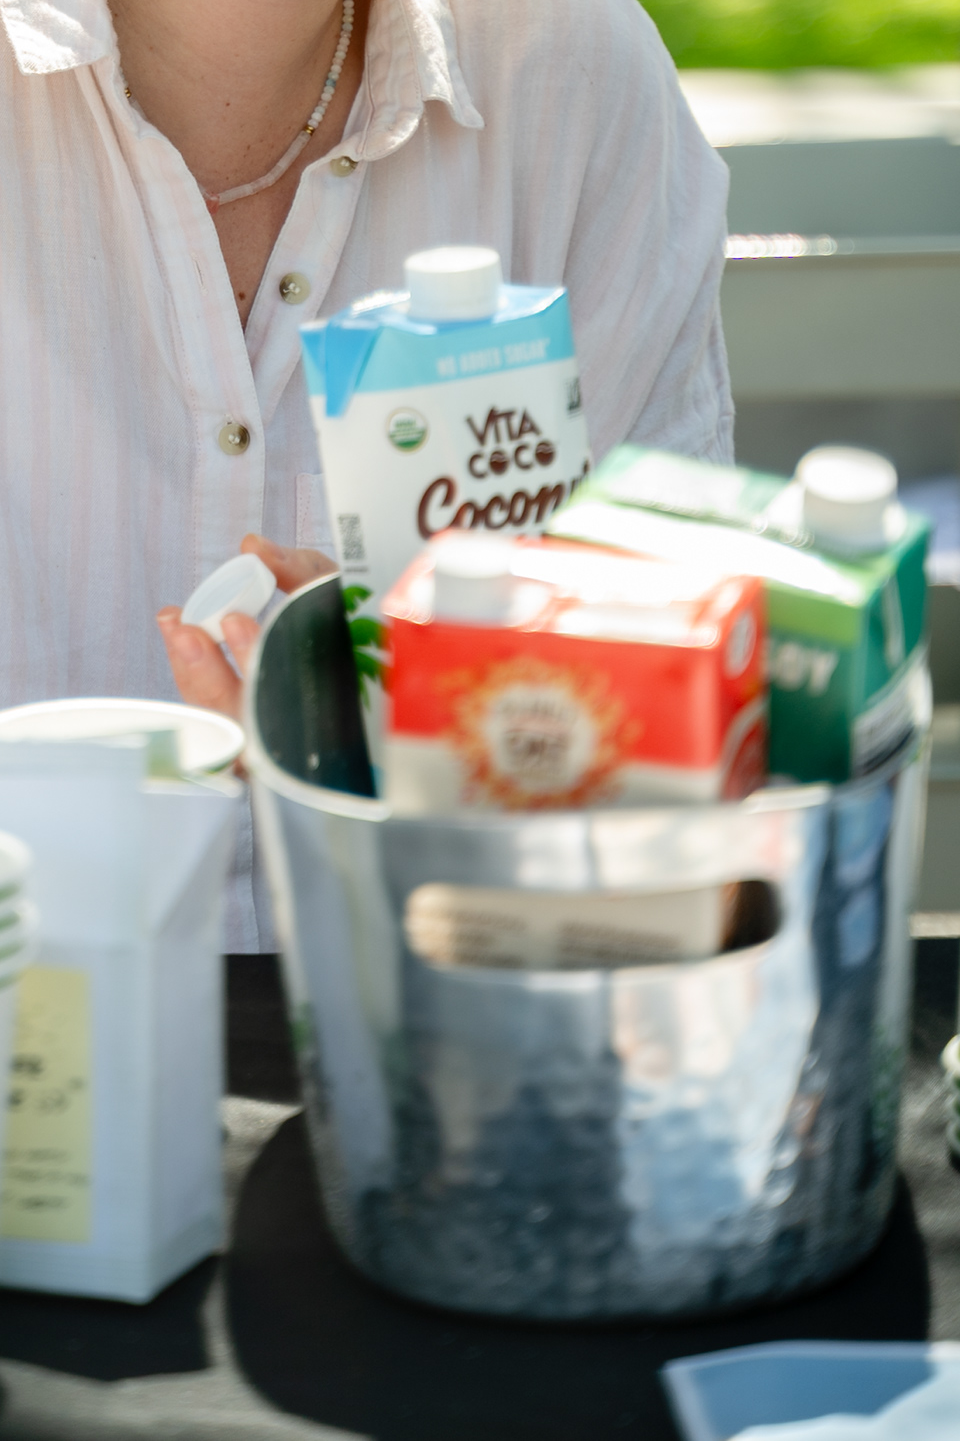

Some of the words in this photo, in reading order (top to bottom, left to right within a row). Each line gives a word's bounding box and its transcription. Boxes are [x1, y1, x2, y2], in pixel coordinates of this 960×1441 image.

[466, 407, 542, 447] VITA
[469, 439, 557, 480] COCO
[417, 459, 590, 541] Cocon
